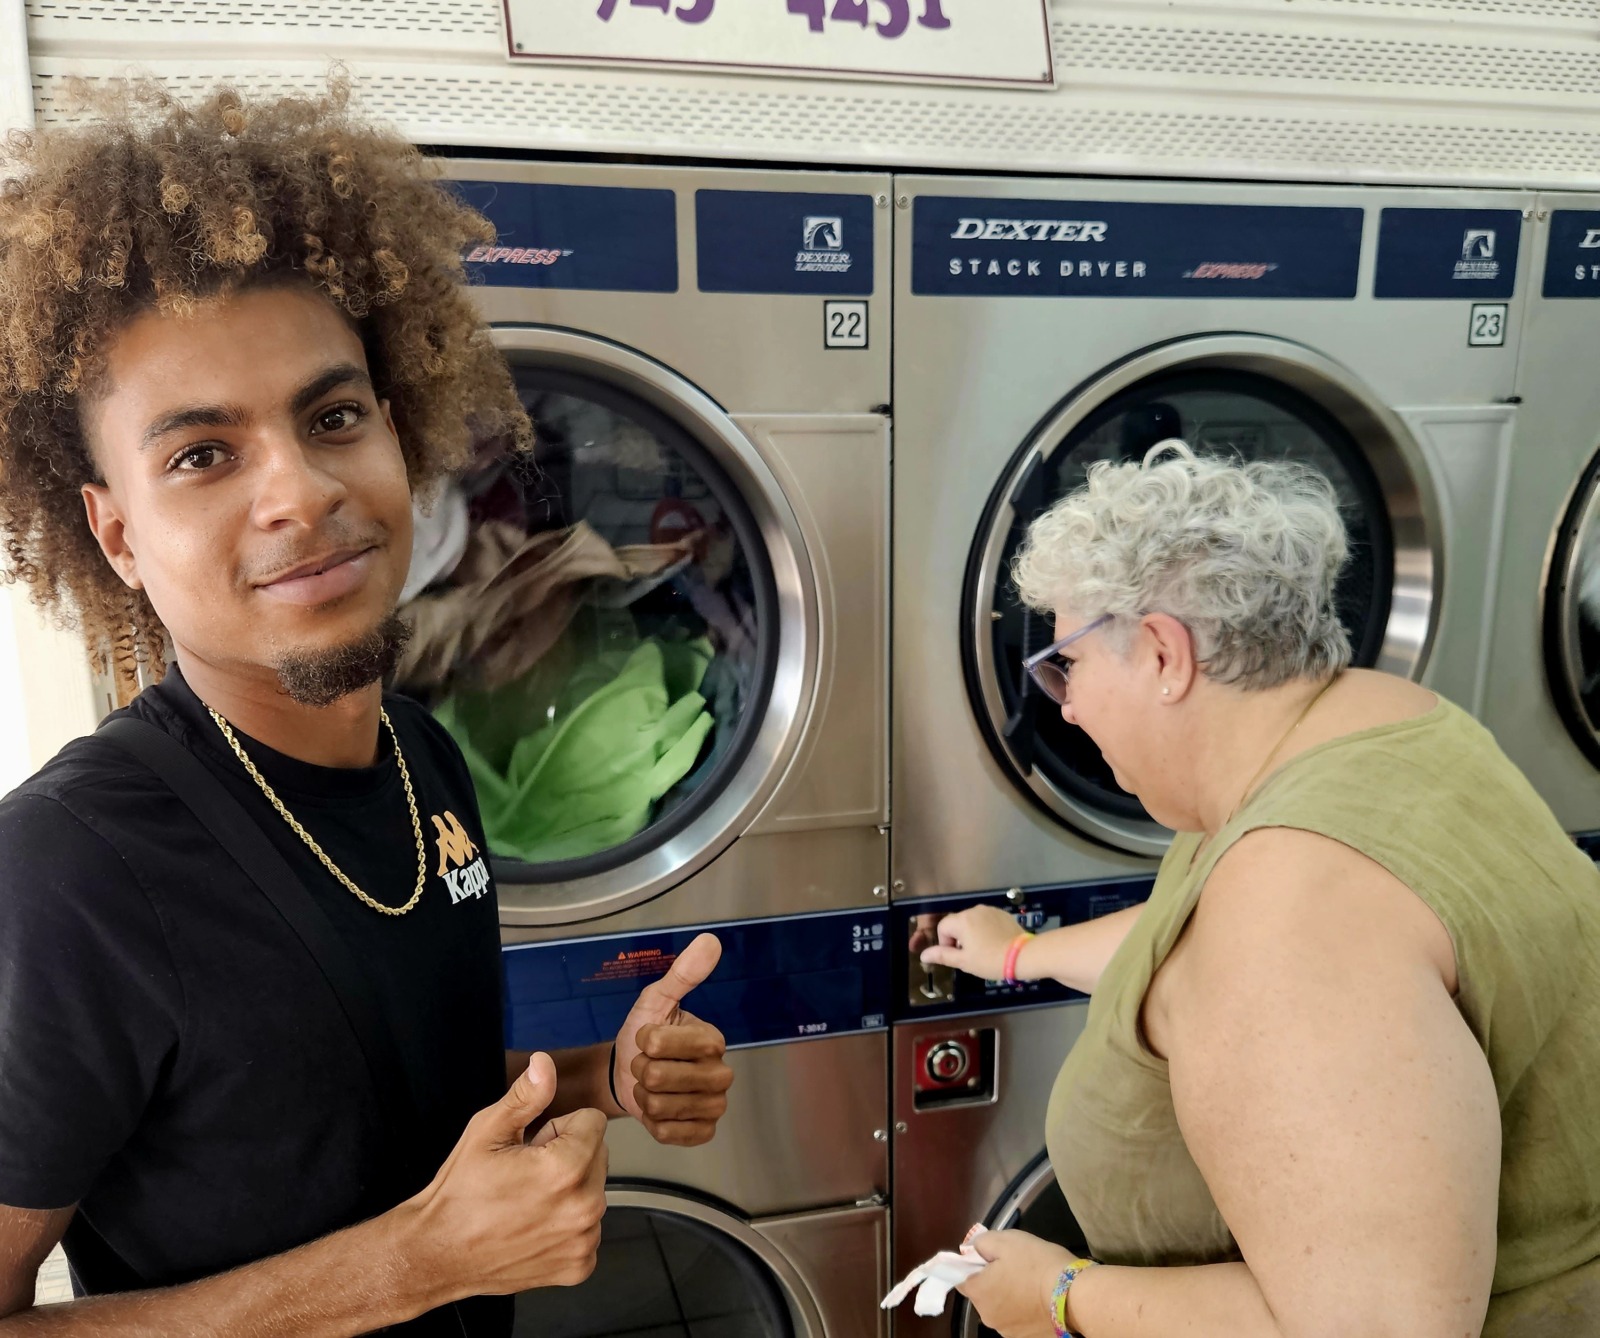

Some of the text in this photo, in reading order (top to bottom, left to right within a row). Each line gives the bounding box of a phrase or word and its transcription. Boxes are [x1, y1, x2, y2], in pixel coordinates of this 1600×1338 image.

[950, 218, 1108, 242] DEXTER
[466, 247, 562, 266] EXPRESS
[795, 252, 851, 262] DEXTER
[949, 257, 1147, 278] STACK DRYER
[830, 312, 862, 339] 22
[1475, 313, 1501, 338] 23
[852, 925, 861, 938] 3
[627, 948, 662, 959] WARNING
[852, 940, 861, 953] 3
